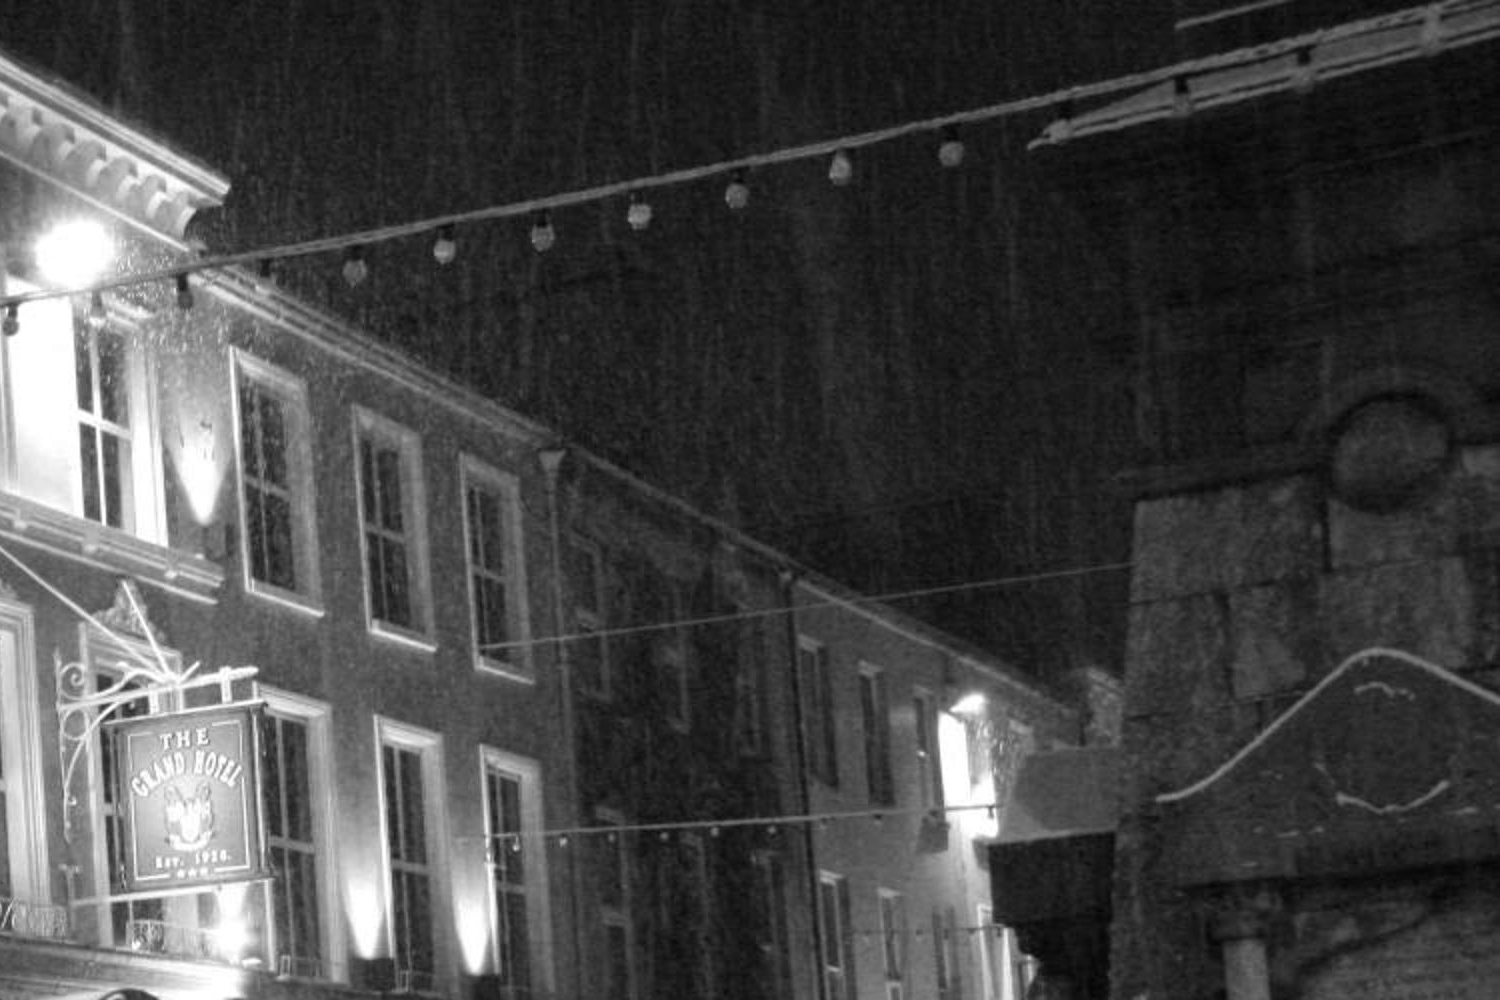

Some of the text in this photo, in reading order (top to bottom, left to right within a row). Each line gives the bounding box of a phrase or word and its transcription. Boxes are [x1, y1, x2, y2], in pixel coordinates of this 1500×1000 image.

[159, 727, 210, 751] THE
[131, 750, 243, 797] GRAND HOTEL
